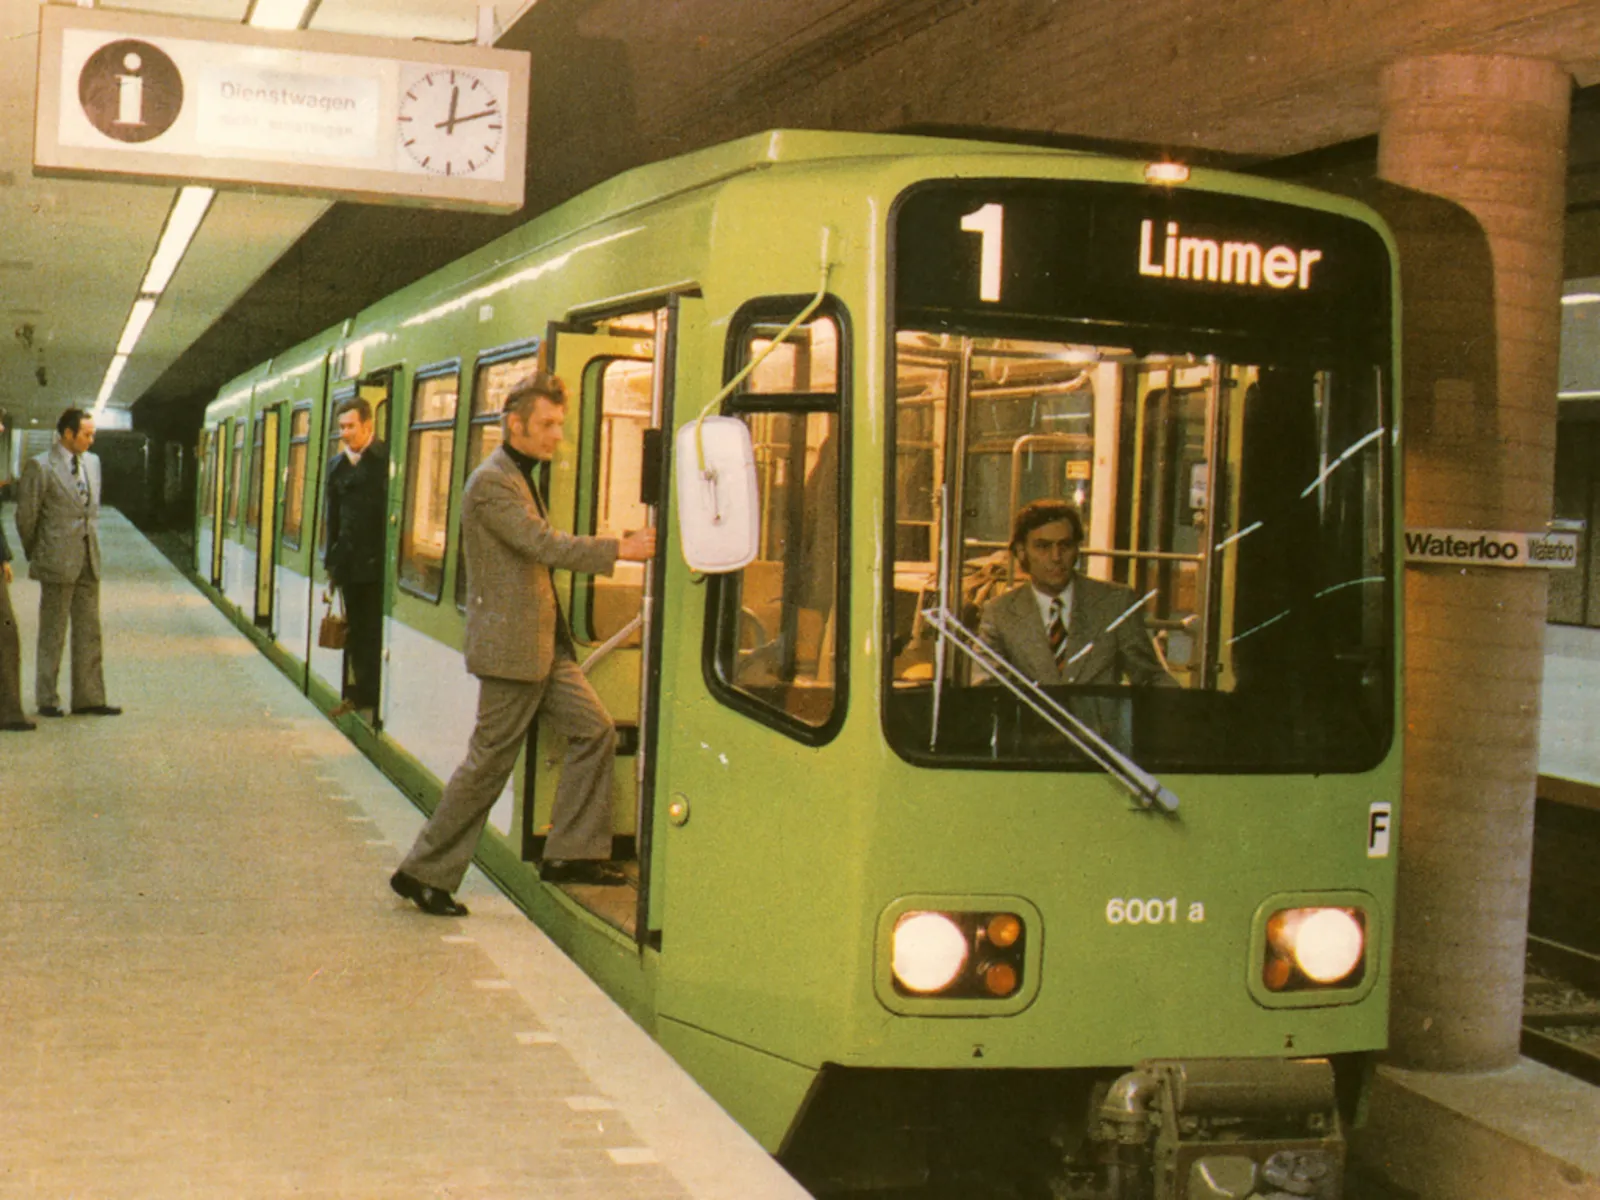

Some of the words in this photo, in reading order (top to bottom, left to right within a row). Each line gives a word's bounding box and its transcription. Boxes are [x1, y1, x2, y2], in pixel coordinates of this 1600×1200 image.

[220, 80, 357, 112] Dienstwagen
[960, 203, 1004, 303] 1
[1138, 220, 1322, 290] Limmer
[1405, 532, 1519, 561] Waterloo
[1369, 811, 1389, 848] F
[1106, 897, 1178, 924] 6001
[1187, 901, 1206, 923] a
